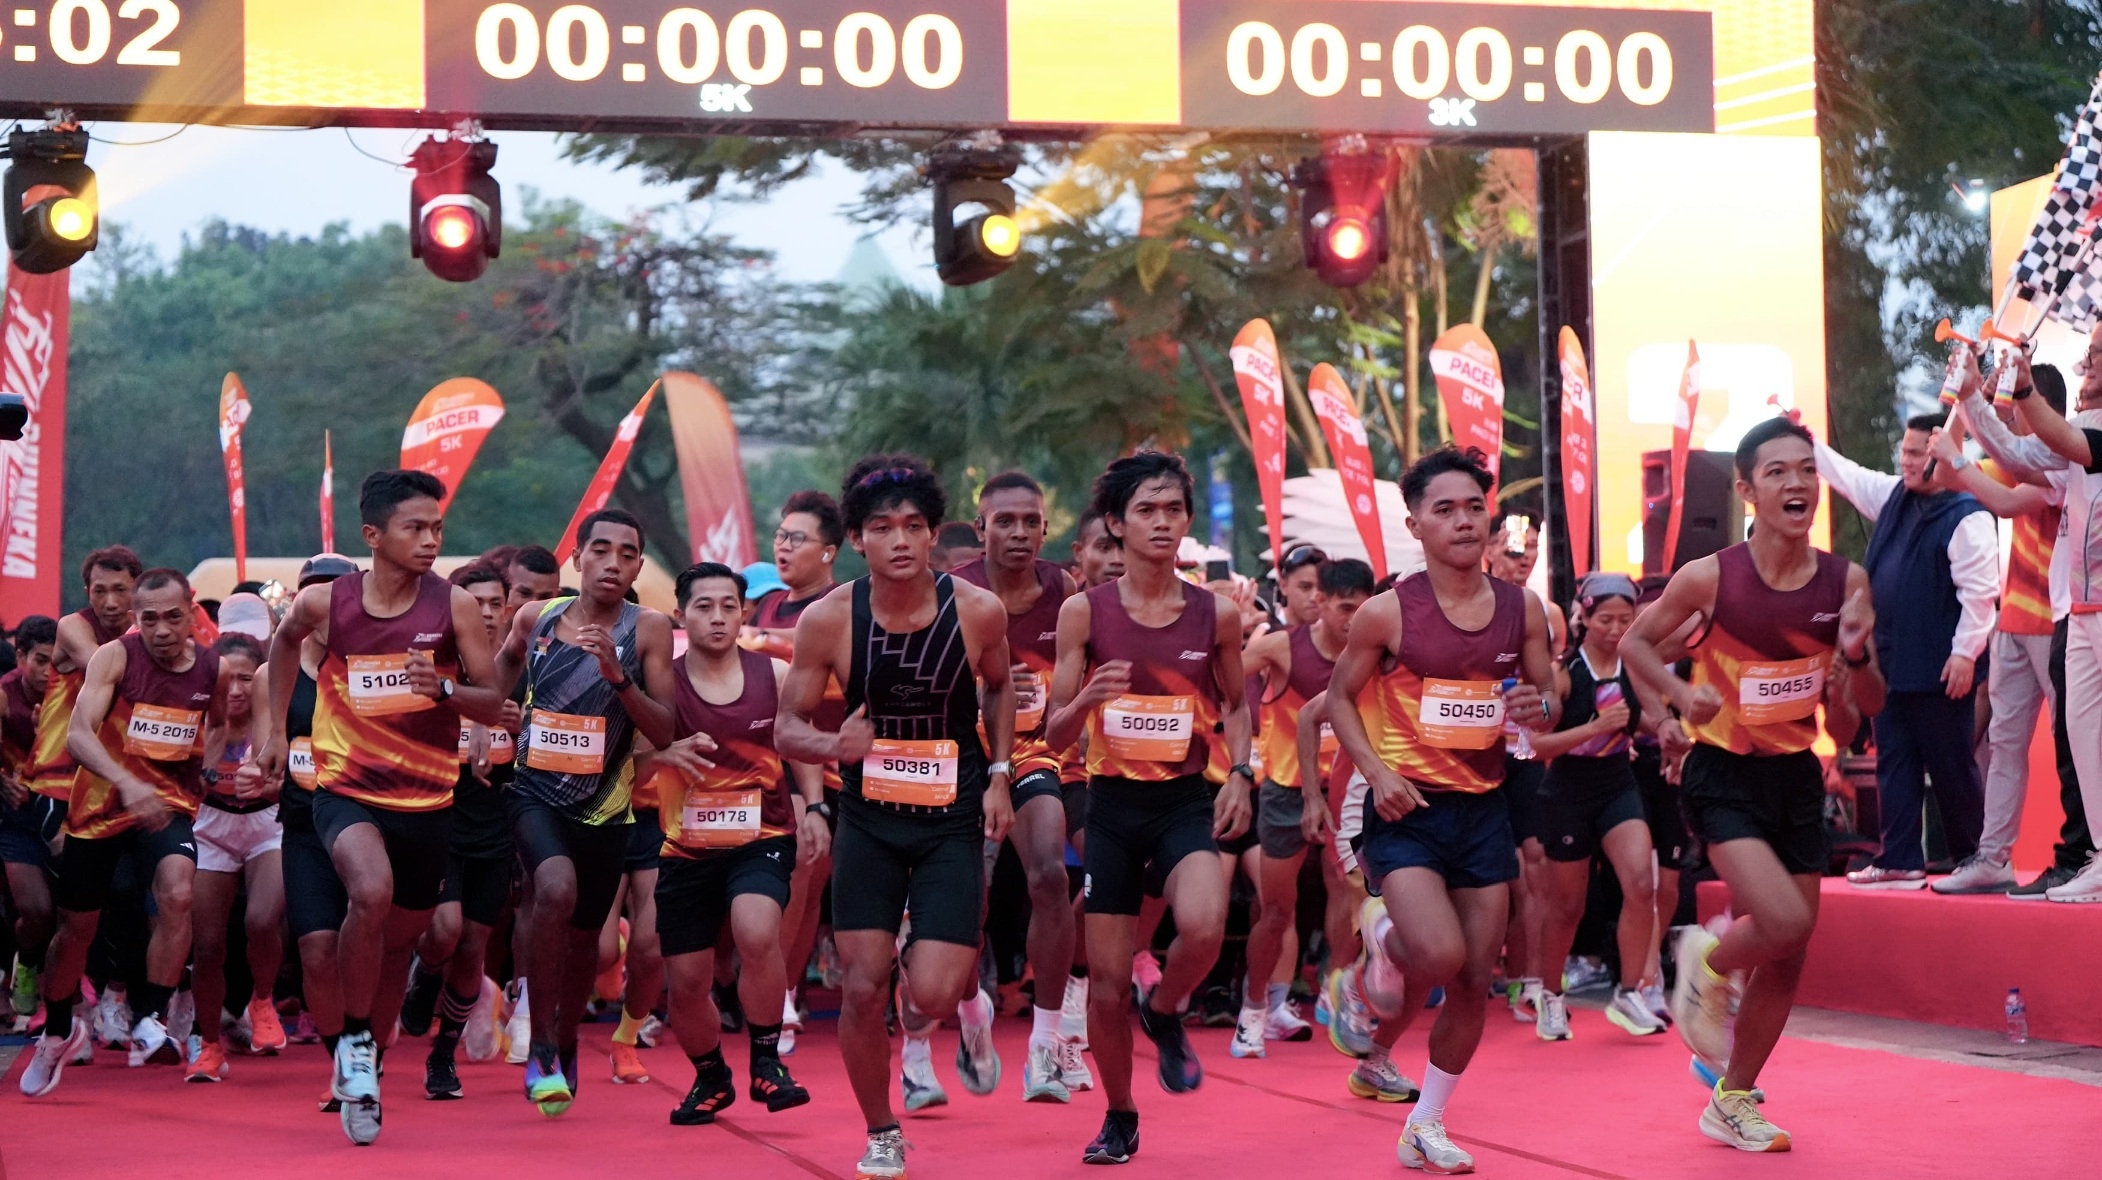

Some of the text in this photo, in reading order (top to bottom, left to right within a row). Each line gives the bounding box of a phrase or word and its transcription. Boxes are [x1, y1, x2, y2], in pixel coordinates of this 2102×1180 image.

[0, 0, 181, 67] :02
[475, 3, 963, 90] 00:00:00
[1226, 21, 1673, 106] 00:00:00
[700, 84, 753, 113] 5K
[1428, 98, 1477, 127] 3K
[1461, 387, 1484, 412] 5K
[426, 410, 479, 436] PACER
[440, 434, 463, 453] 5K
[1759, 676, 1814, 696] 50455
[1440, 703, 1495, 718] 50450
[133, 721, 196, 739] M-5 2015
[584, 718, 598, 730] 5K
[1122, 716, 1180, 732] 50092
[541, 730, 590, 748] 50513
[935, 742, 950, 756] 5K
[883, 758, 940, 776] 50381
[741, 793, 754, 804] 5K
[697, 810, 747, 822] 50178
